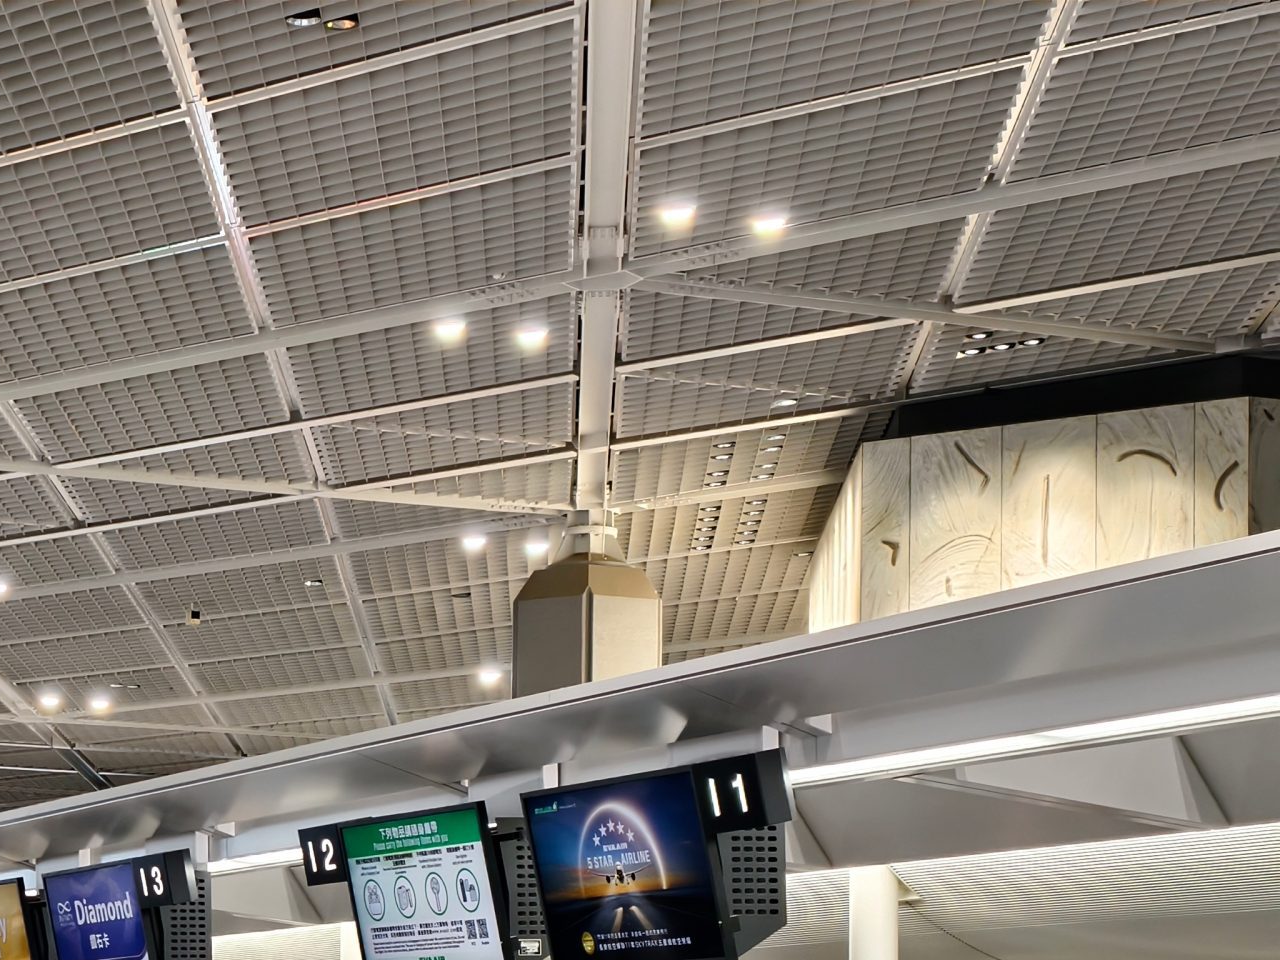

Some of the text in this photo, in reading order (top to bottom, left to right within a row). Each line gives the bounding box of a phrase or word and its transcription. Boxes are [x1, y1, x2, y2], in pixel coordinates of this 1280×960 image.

[708, 773, 748, 817] 11
[308, 838, 337, 873] 12
[594, 855, 614, 869] STAR
[620, 850, 651, 866] AIRLINE
[139, 866, 164, 897] 13
[74, 891, 134, 926] Diamond
